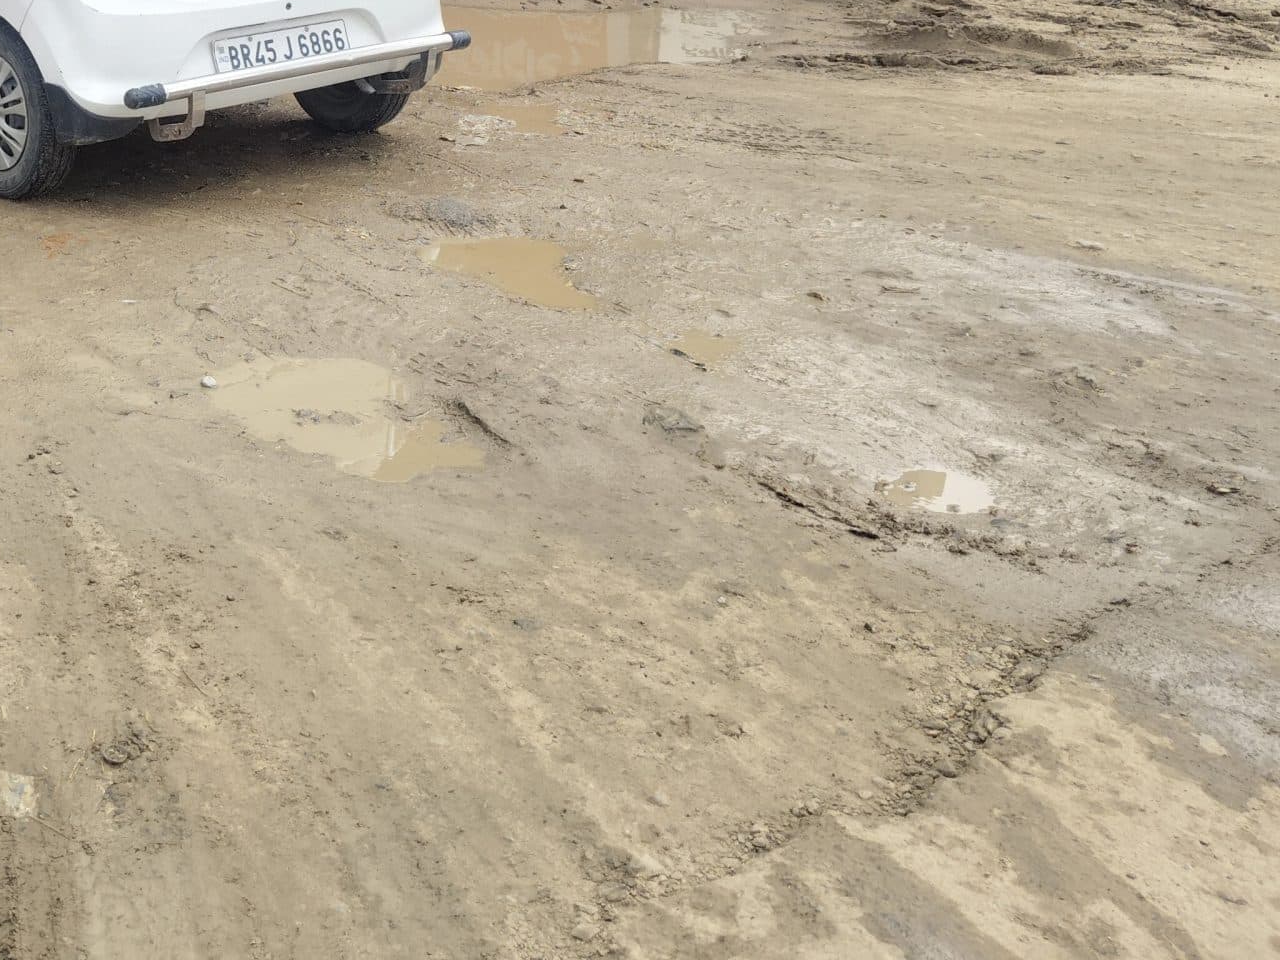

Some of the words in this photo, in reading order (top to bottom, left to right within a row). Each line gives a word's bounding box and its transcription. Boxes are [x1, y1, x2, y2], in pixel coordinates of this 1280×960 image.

[228, 39, 277, 70] BR45
[283, 35, 294, 60] J
[297, 27, 346, 57] 6866
